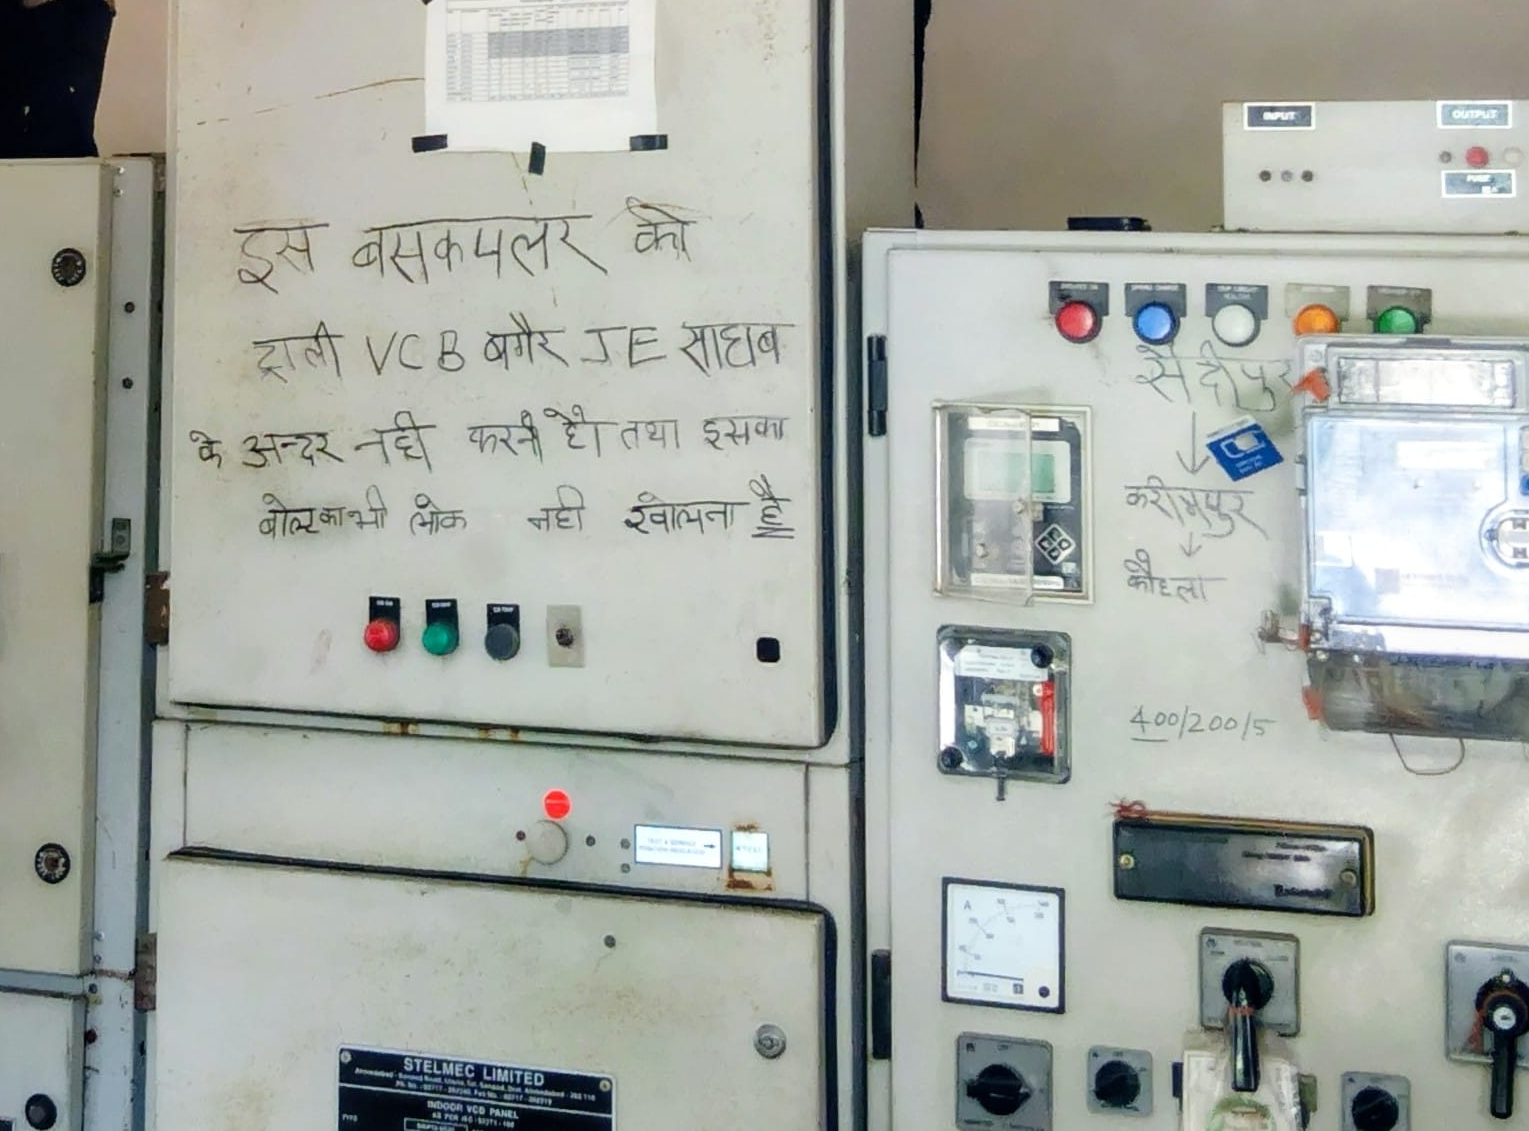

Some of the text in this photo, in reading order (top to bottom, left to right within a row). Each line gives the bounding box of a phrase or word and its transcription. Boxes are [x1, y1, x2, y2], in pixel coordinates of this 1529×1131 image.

[1263, 111, 1296, 121] INPUT
[1452, 109, 1498, 120] OUTPUT
[233, 222, 330, 294] इस
[620, 419, 680, 450] तथा
[1130, 705, 1278, 741] 400/200/5
[404, 1057, 475, 1078] STELMEC
[483, 1067, 545, 1086] LIMITED
[427, 1100, 464, 1112] INDOOR
[489, 1108, 519, 1119] PANEL
